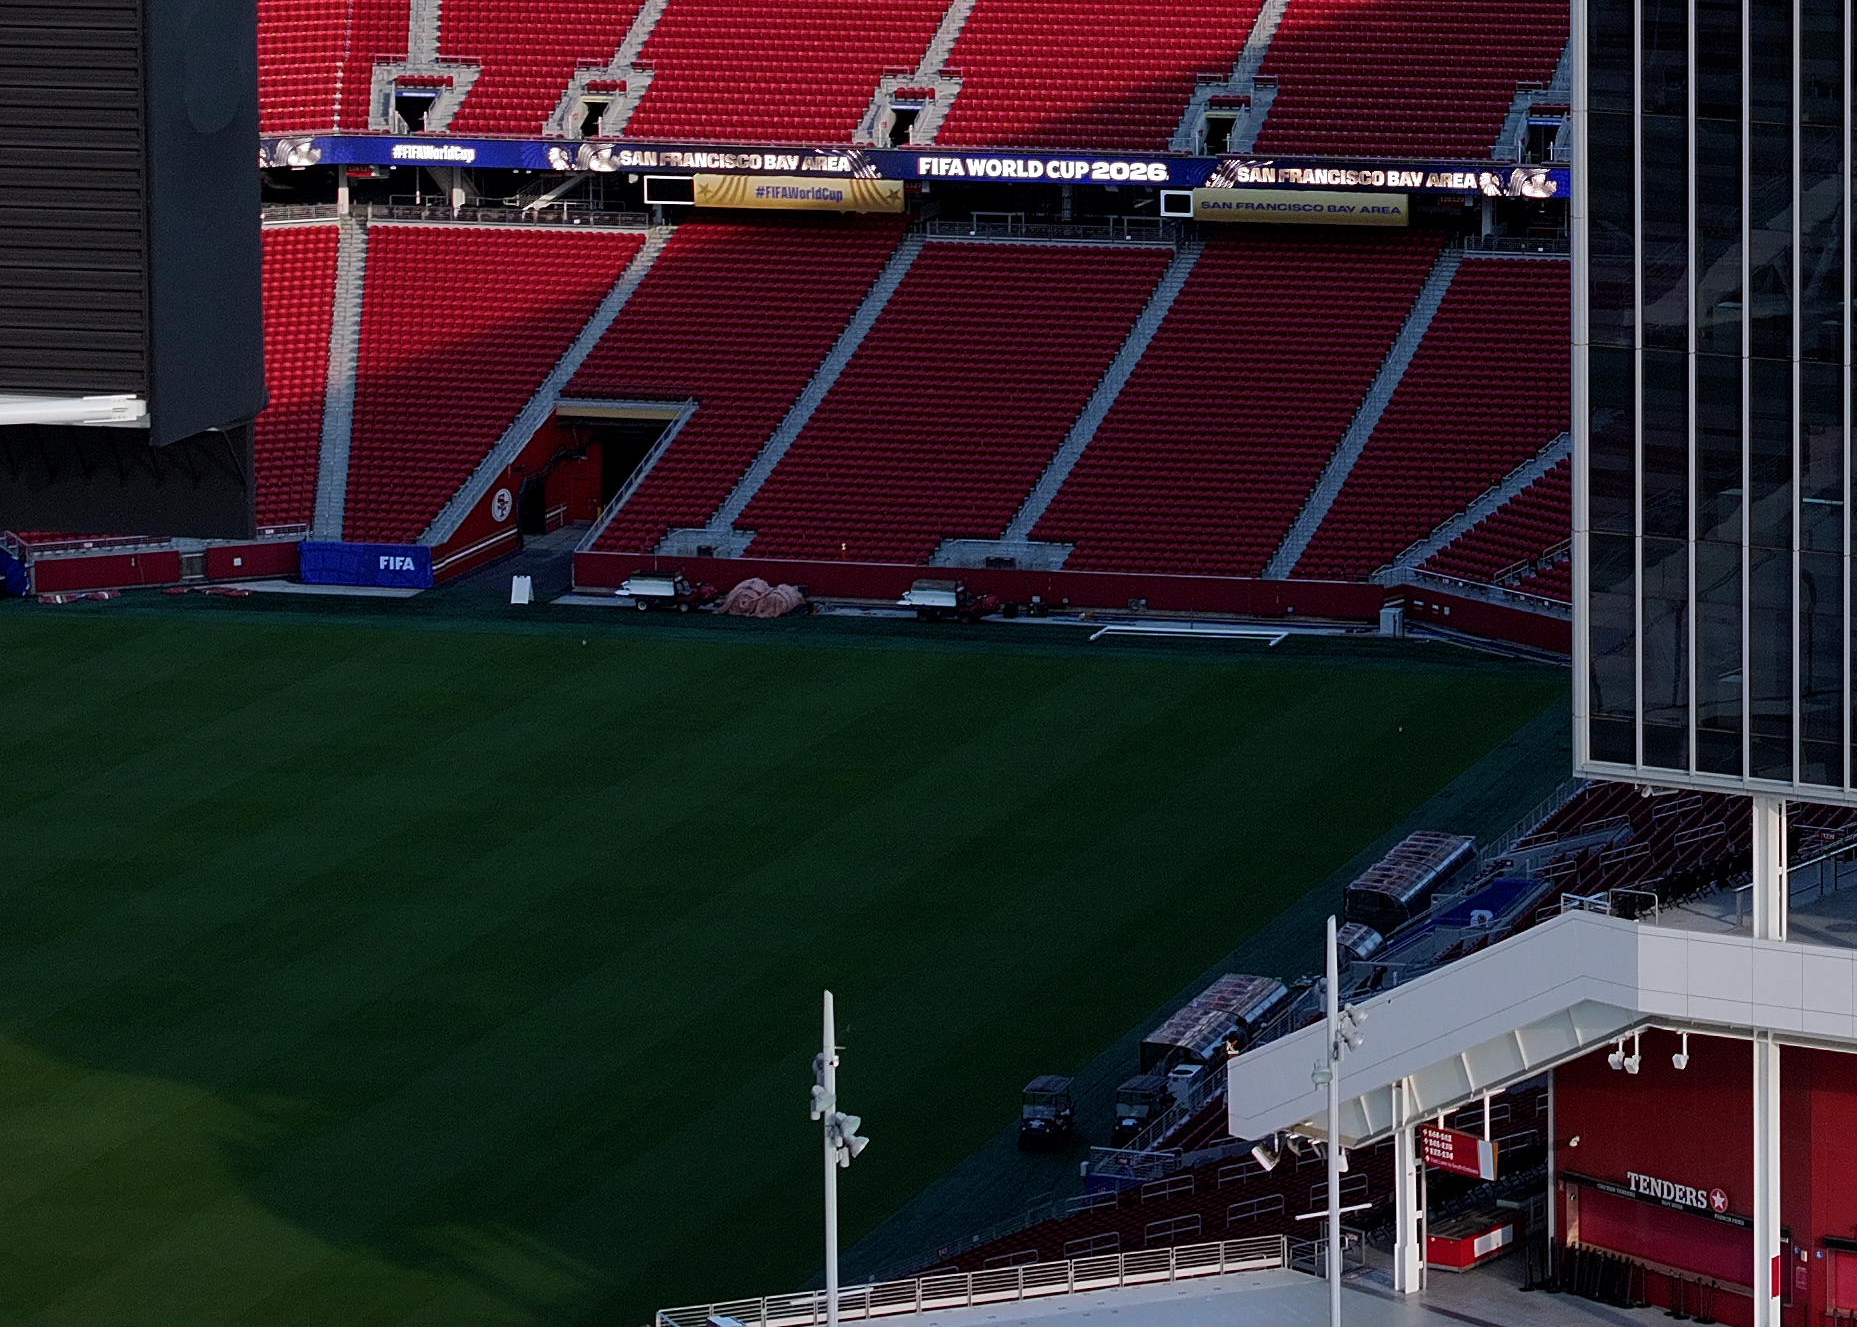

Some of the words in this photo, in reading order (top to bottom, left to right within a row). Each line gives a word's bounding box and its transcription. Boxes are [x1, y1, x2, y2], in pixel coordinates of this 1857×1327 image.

[391, 144, 476, 163] #FIFAWorldCup
[619, 150, 657, 167] SAN
[659, 152, 761, 170] FRANCISCO
[763, 154, 801, 170] BAY
[802, 155, 851, 172] AREA
[917, 157, 965, 176] FIFA
[965, 158, 1044, 178] WORLD
[1046, 160, 1090, 179] CUP
[1091, 162, 1168, 181] 2026
[1237, 166, 1277, 184] SAN
[1278, 168, 1385, 187] FRANCISCO
[1387, 171, 1424, 188] BAY
[1425, 172, 1478, 189] AREA
[755, 185, 843, 203] #FIFAWorldCup
[1200, 200, 1234, 210] SAN
[1235, 201, 1325, 213] FRANCISCO
[1327, 203, 1357, 213] BAY
[1359, 204, 1402, 215] AREA
[379, 555, 416, 572] FIFA
[1626, 1171, 1708, 1210] TENDERS
